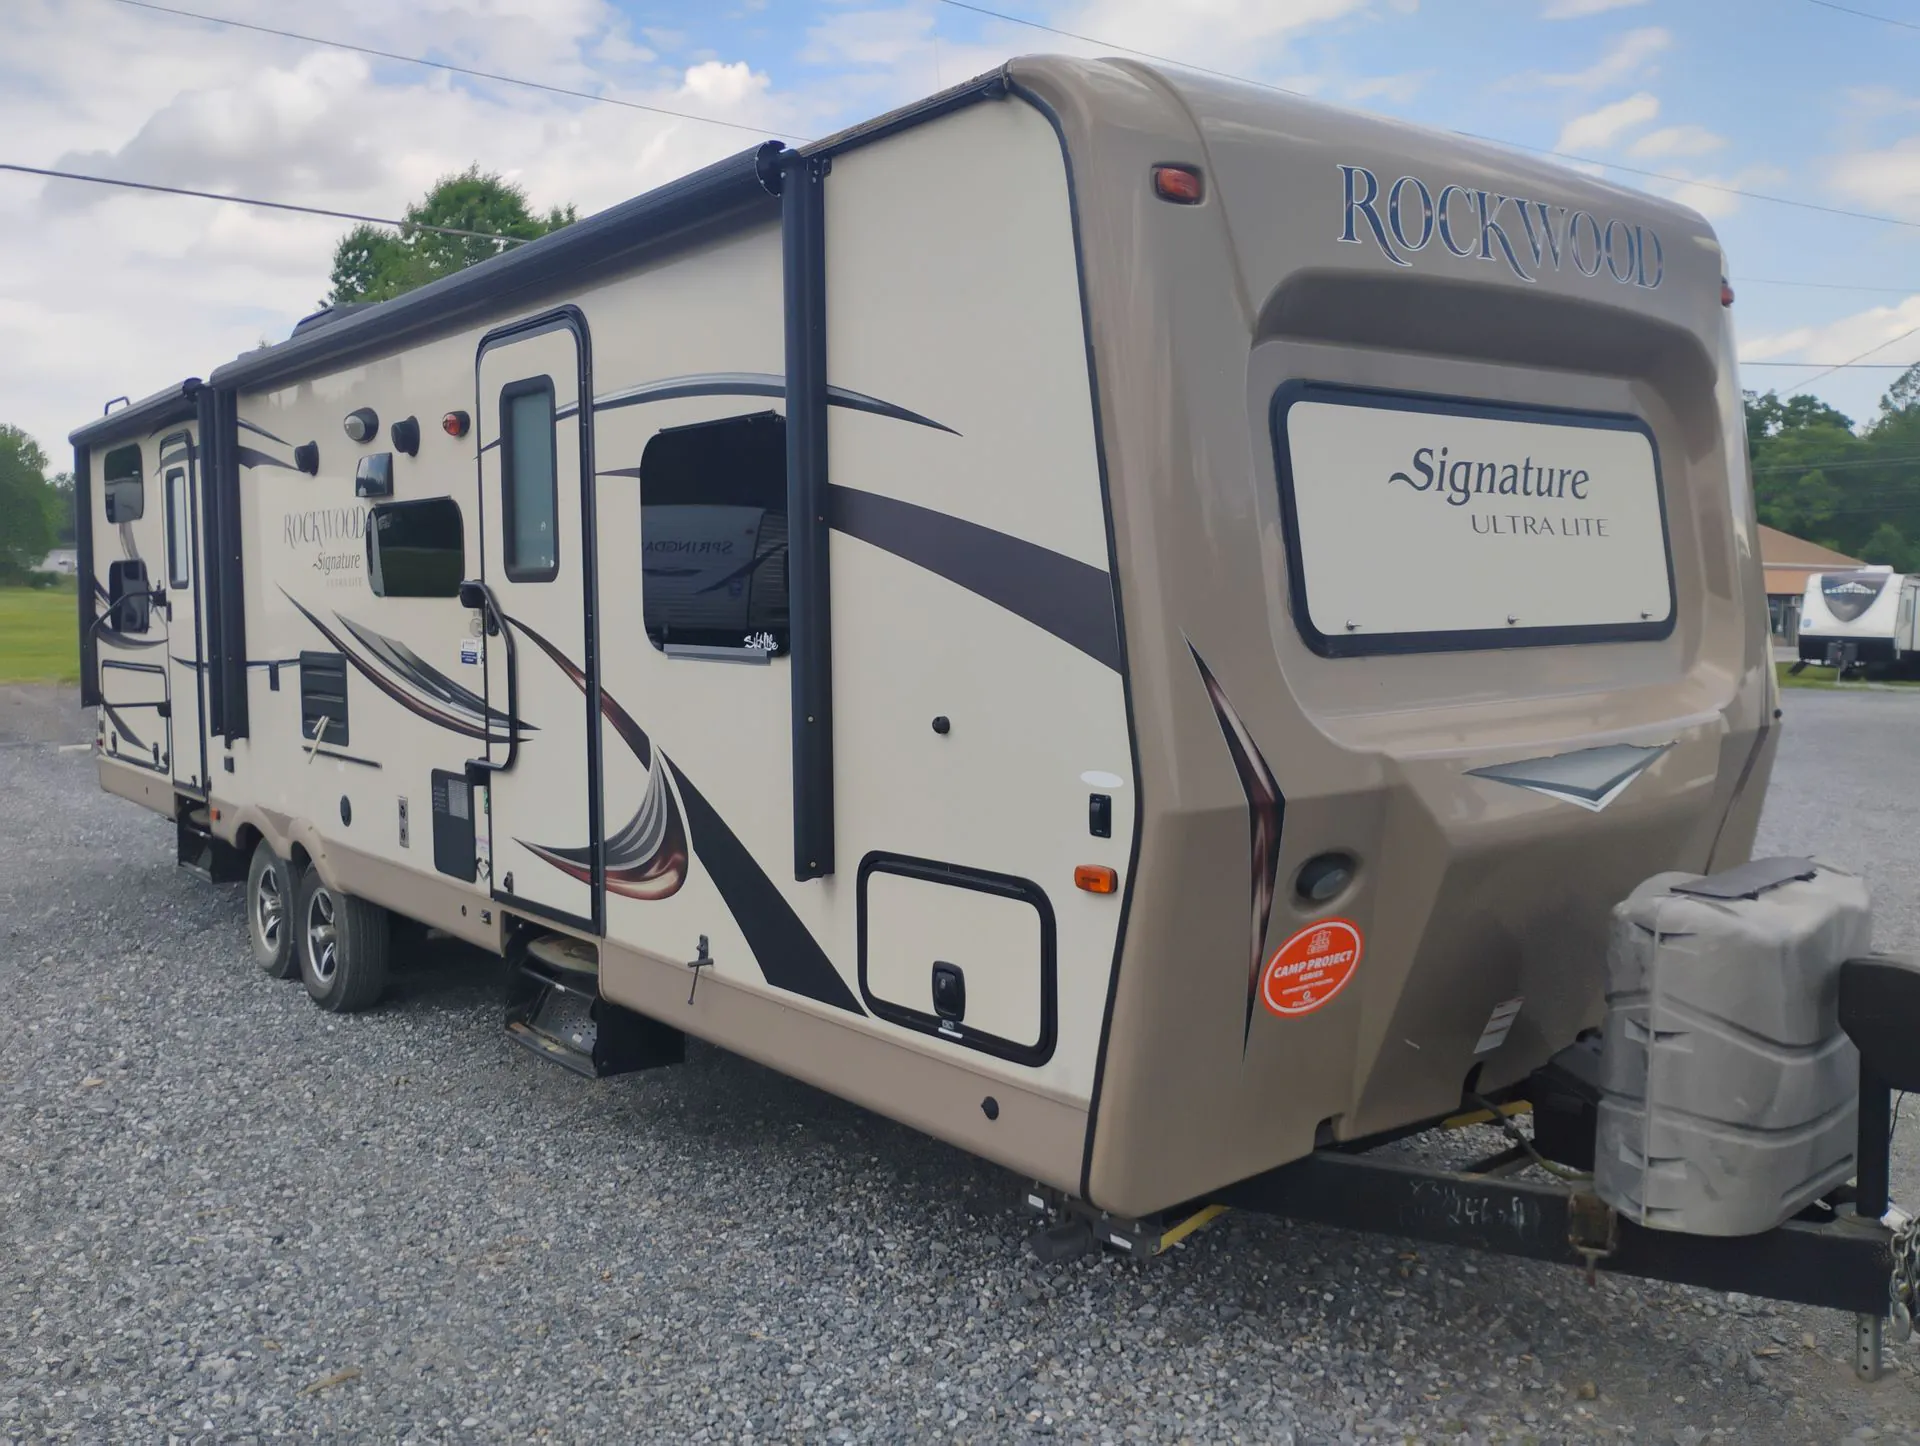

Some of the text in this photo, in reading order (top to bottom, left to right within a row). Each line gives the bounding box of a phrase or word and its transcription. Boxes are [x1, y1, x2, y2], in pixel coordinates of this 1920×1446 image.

[1336, 164, 1664, 289] ROCKWOOD
[1388, 447, 1589, 506] Signature
[283, 505, 366, 550] ROCKWOOD
[1471, 514, 1610, 537] ULTRA LITE
[312, 551, 361, 576] Signature
[1274, 961, 1307, 978] CAMP
[1307, 950, 1353, 970] PROJECT
